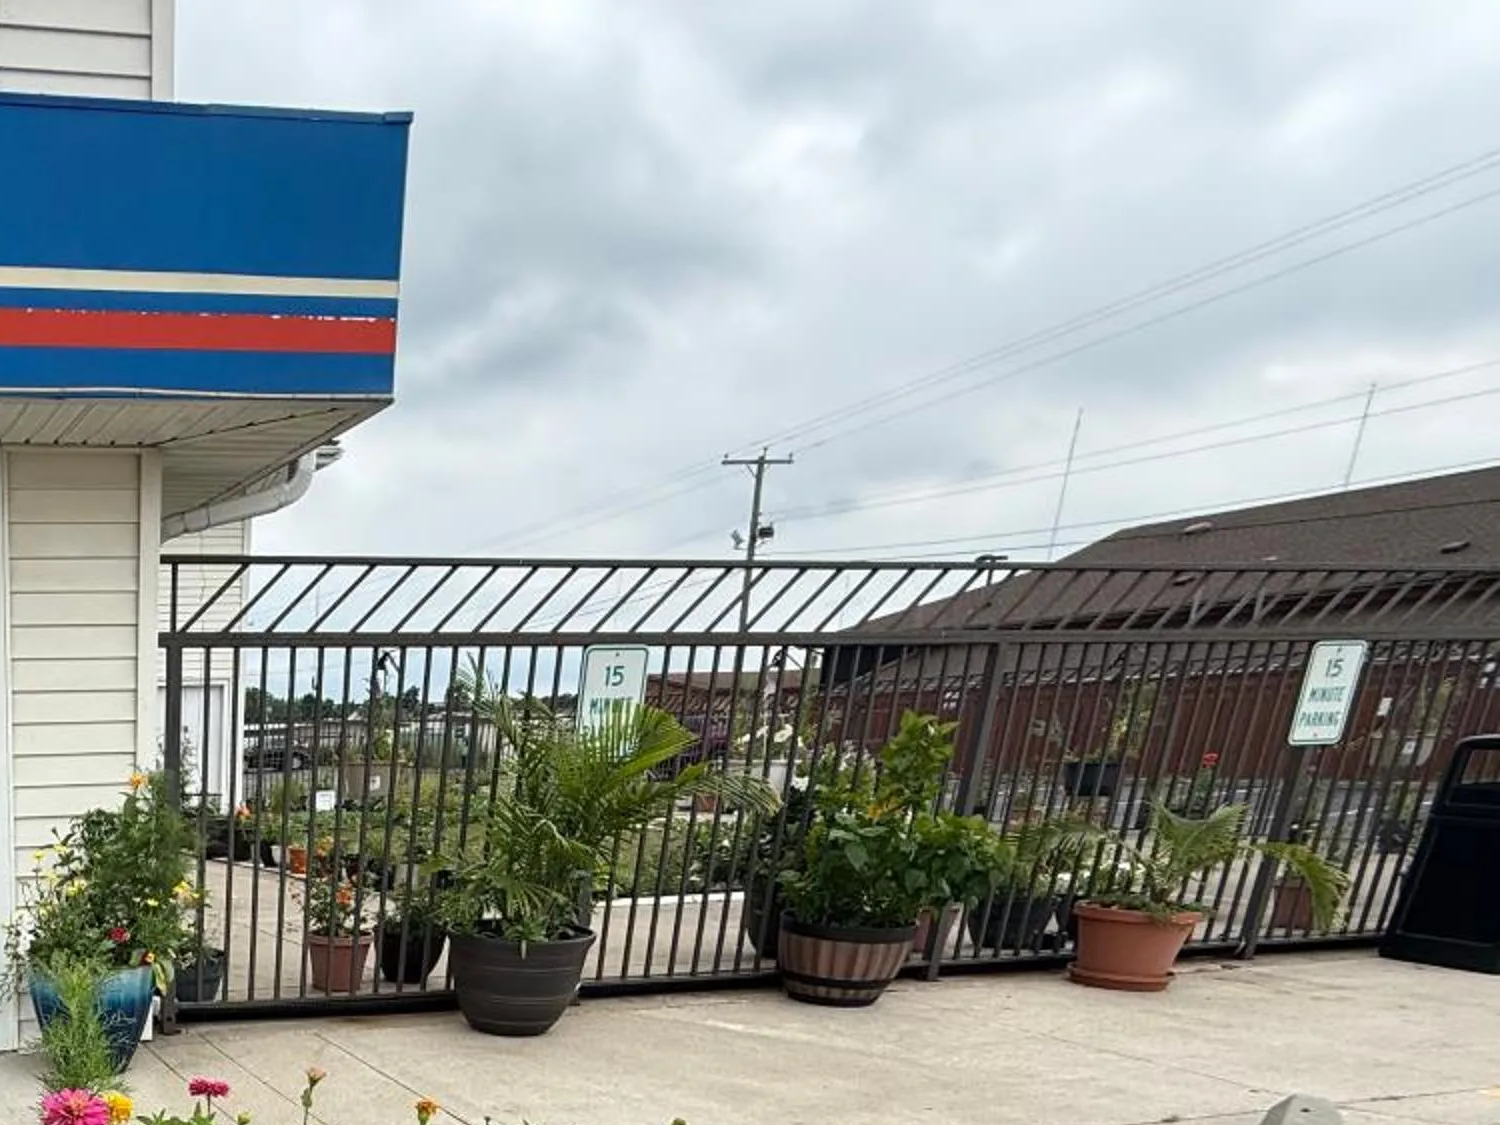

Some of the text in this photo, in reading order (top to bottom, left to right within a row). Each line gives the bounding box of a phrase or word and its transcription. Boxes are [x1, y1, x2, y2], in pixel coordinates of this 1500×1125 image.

[605, 665, 625, 687] 15
[1326, 659, 1344, 677] 15
[1308, 687, 1346, 702] MINUTE
[1298, 711, 1341, 727] PARKING
